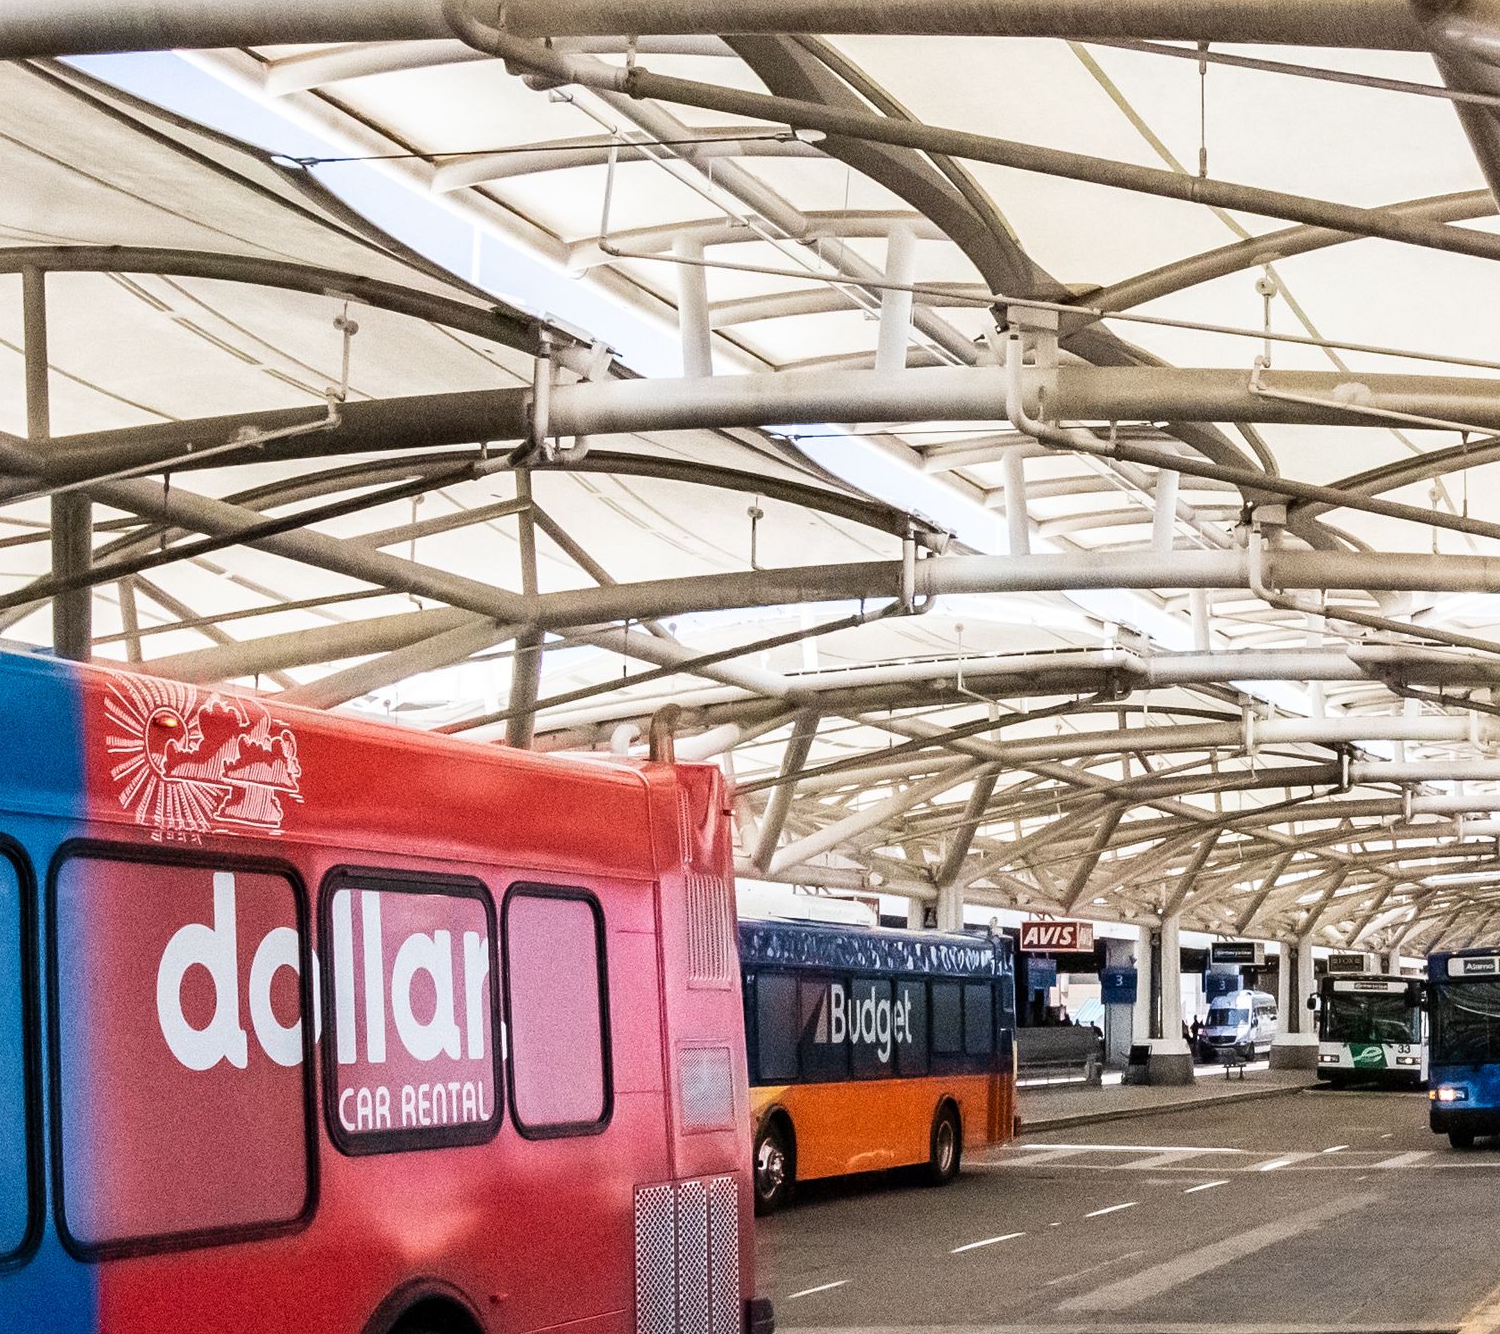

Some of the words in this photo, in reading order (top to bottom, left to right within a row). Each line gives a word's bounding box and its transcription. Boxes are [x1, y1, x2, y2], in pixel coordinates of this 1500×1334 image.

[1023, 926, 1075, 946] AVIS
[156, 871, 490, 1071] dollar
[1116, 974, 1123, 987] 3
[831, 983, 912, 1064] Budget
[1397, 1044, 1411, 1055] 33
[337, 1083, 391, 1132] CAR
[401, 1081, 490, 1128] RENTAL
